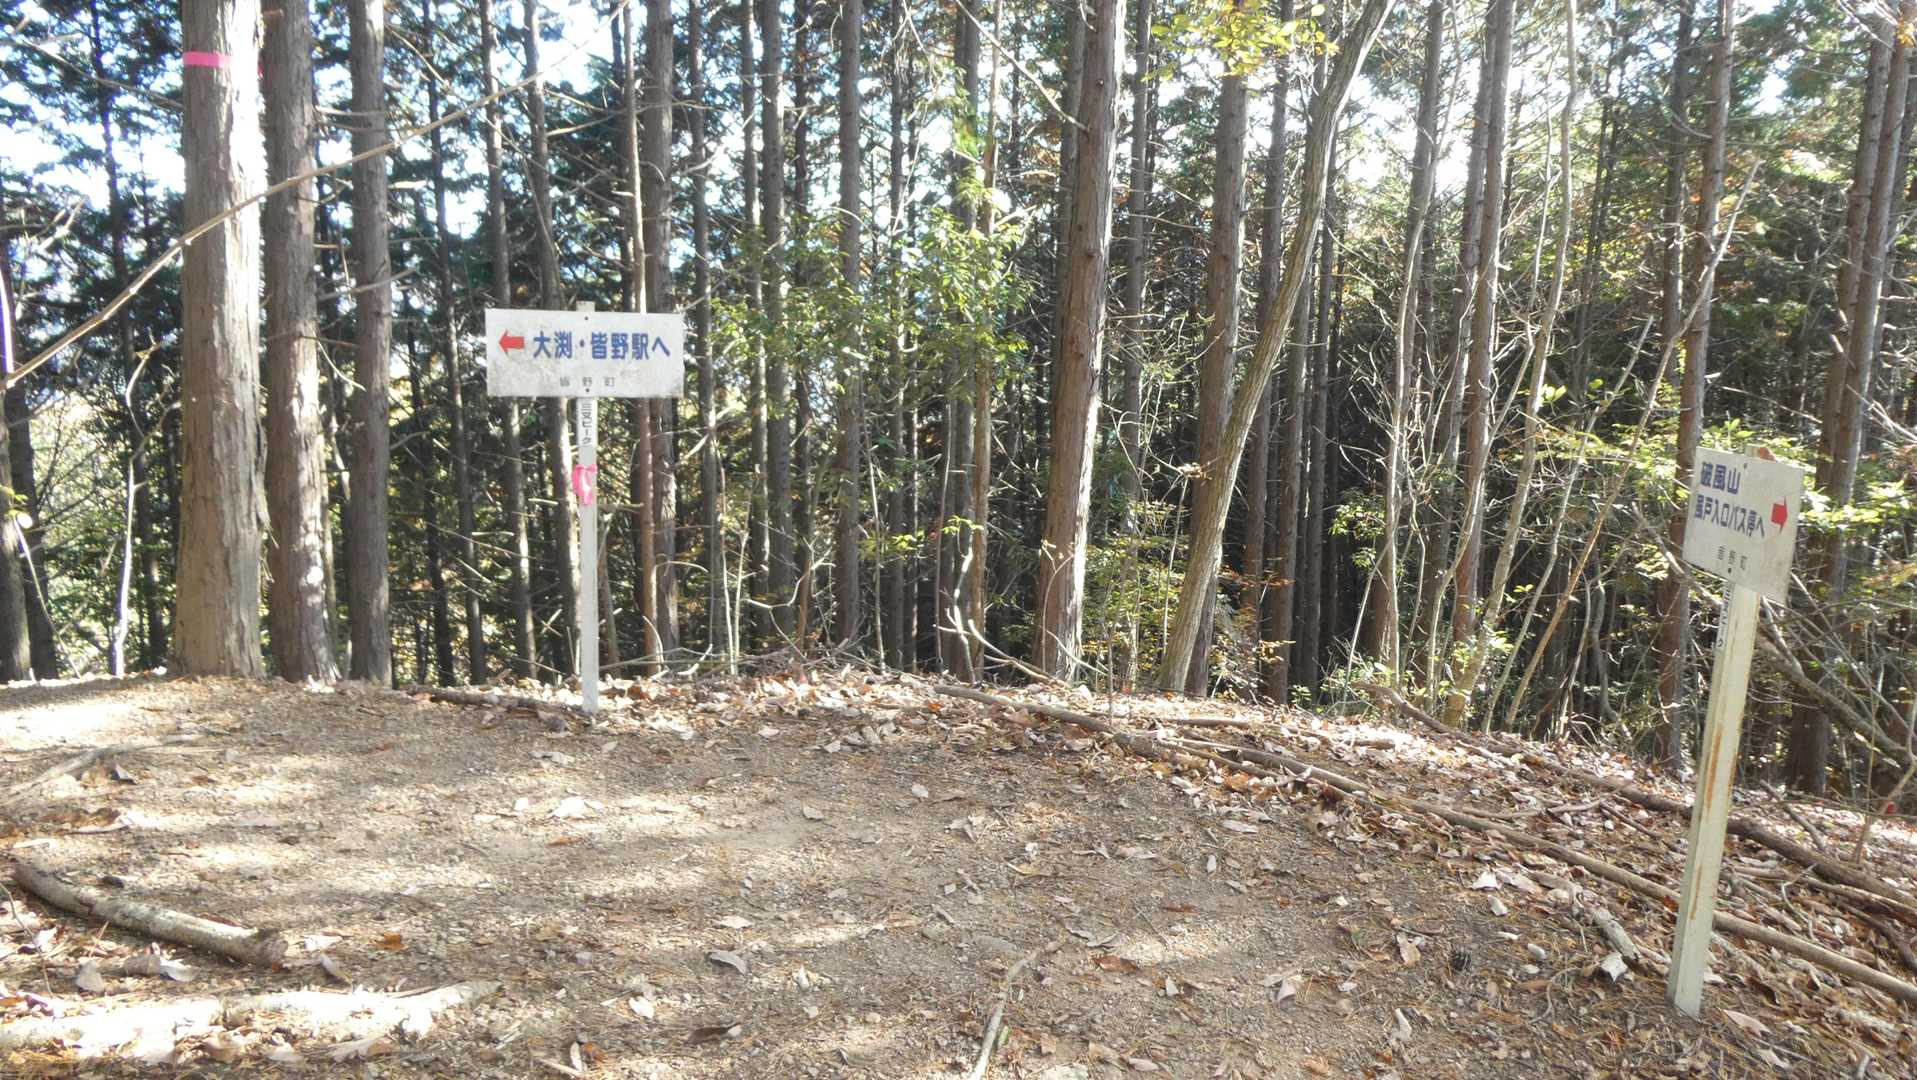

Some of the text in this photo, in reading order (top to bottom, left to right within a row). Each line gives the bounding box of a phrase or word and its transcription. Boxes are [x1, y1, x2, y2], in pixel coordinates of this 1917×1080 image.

[533, 331, 671, 360] 大渕・皆野駅へ
[1700, 462, 1741, 494] 破風山
